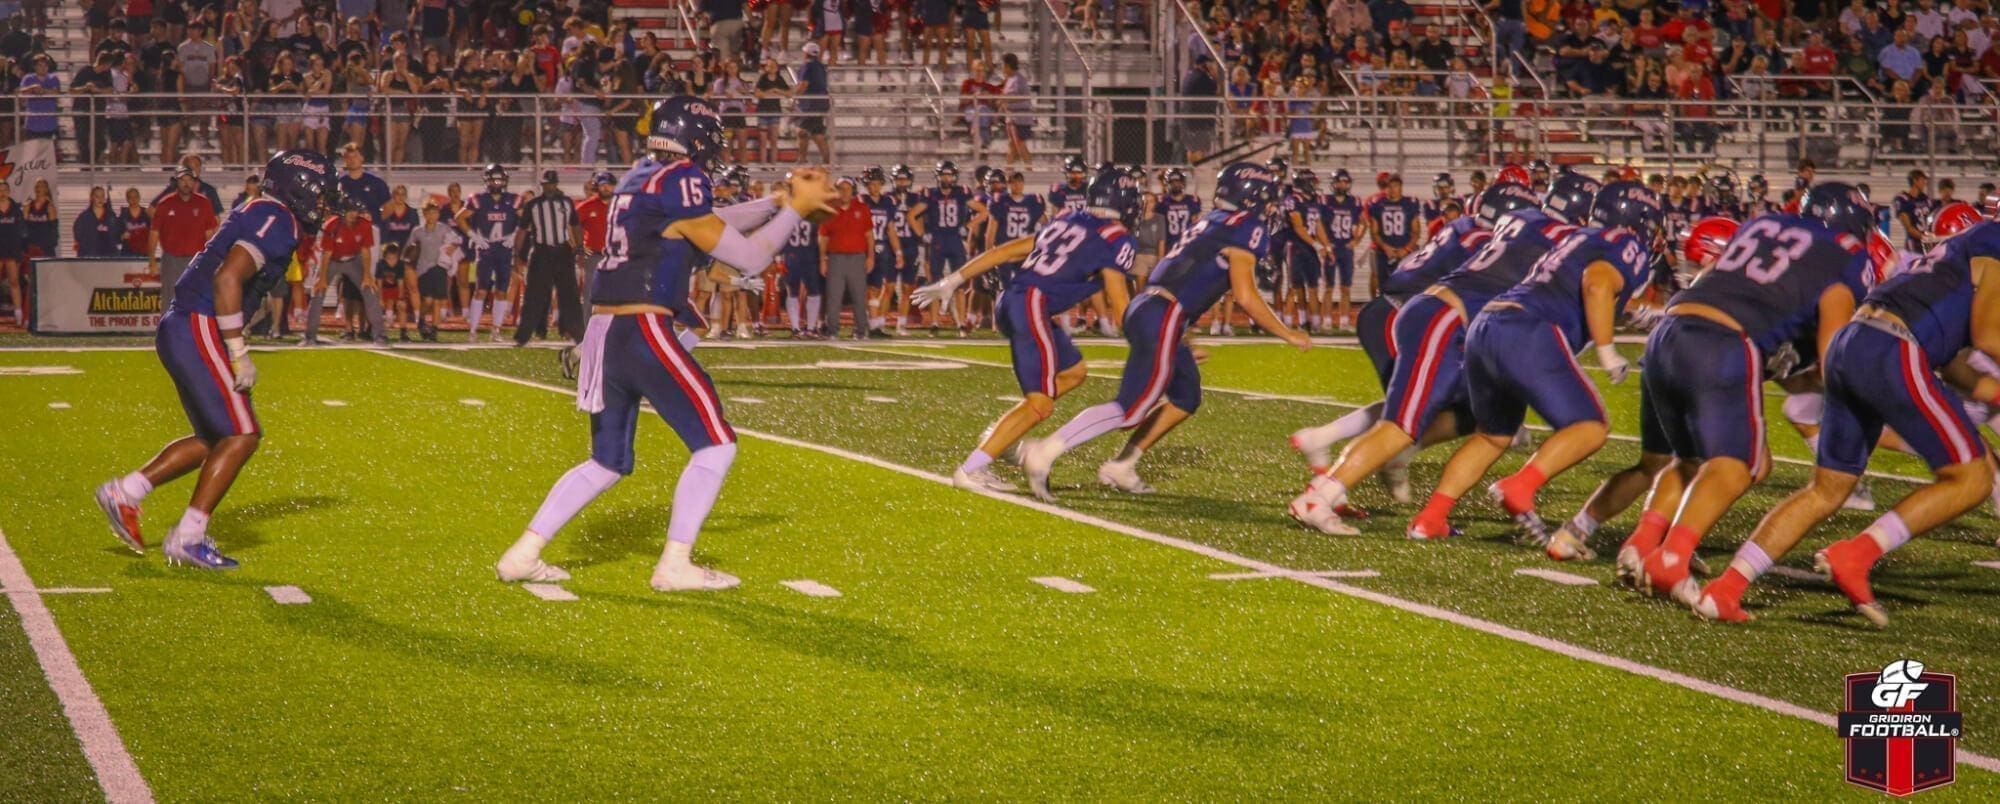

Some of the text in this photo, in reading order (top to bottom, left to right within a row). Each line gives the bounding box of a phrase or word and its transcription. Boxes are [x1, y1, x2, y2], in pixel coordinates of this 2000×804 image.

[680, 177, 703, 207] 15
[256, 214, 276, 238] 1
[938, 201, 957, 228] 18
[1007, 212, 1030, 238] 62
[1167, 210, 1190, 235] 87
[1331, 214, 1352, 239] 49
[1381, 211, 1404, 236] 68
[1021, 220, 1087, 276] 83
[1715, 218, 1812, 284] 63
[88, 316, 106, 328] THE
[108, 316, 138, 327] PROOF
[141, 316, 151, 327] IS
